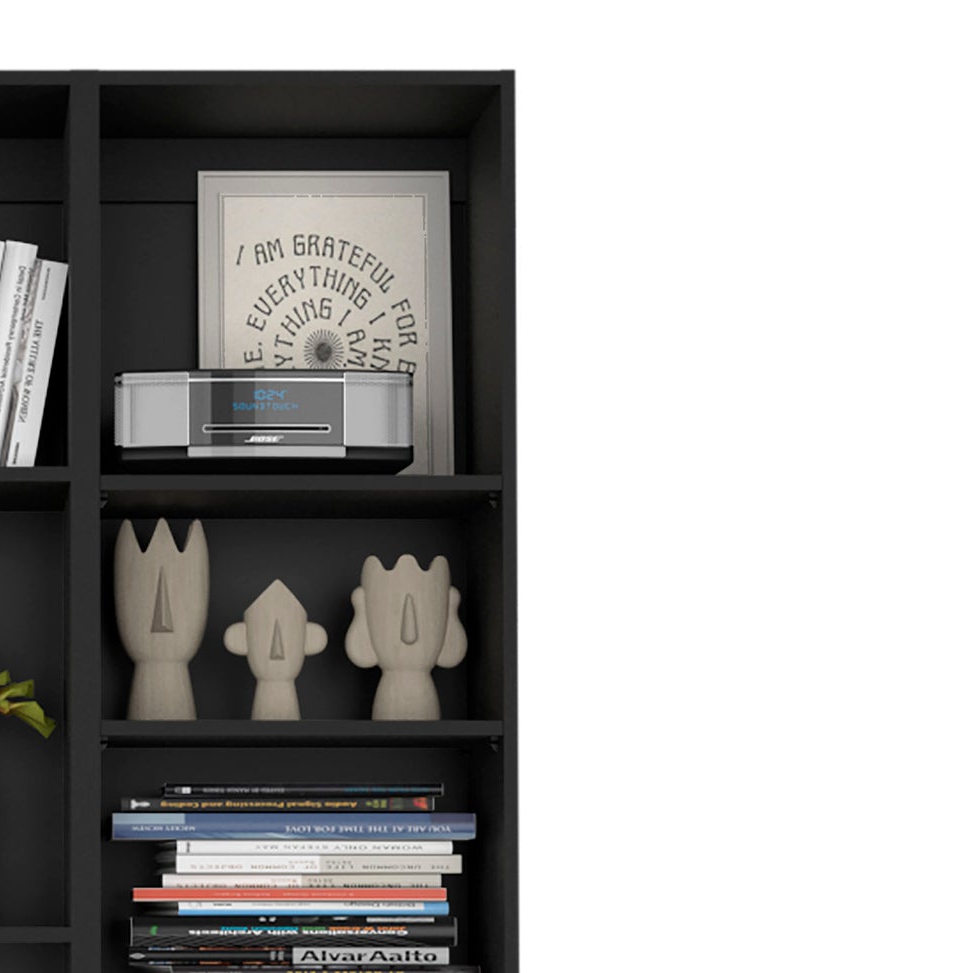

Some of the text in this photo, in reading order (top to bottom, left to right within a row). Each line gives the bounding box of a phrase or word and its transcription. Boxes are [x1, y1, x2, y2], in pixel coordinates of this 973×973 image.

[235, 233, 418, 347] I AM GRATEFUL FOR
[246, 265, 372, 332] EVERYTHING
[274, 297, 332, 368] YTHING
[159, 799, 357, 808] Audio Signal Processing and Coding
[283, 824, 311, 833] LOVE
[367, 824, 387, 833] THE
[428, 824, 451, 833] YOU
